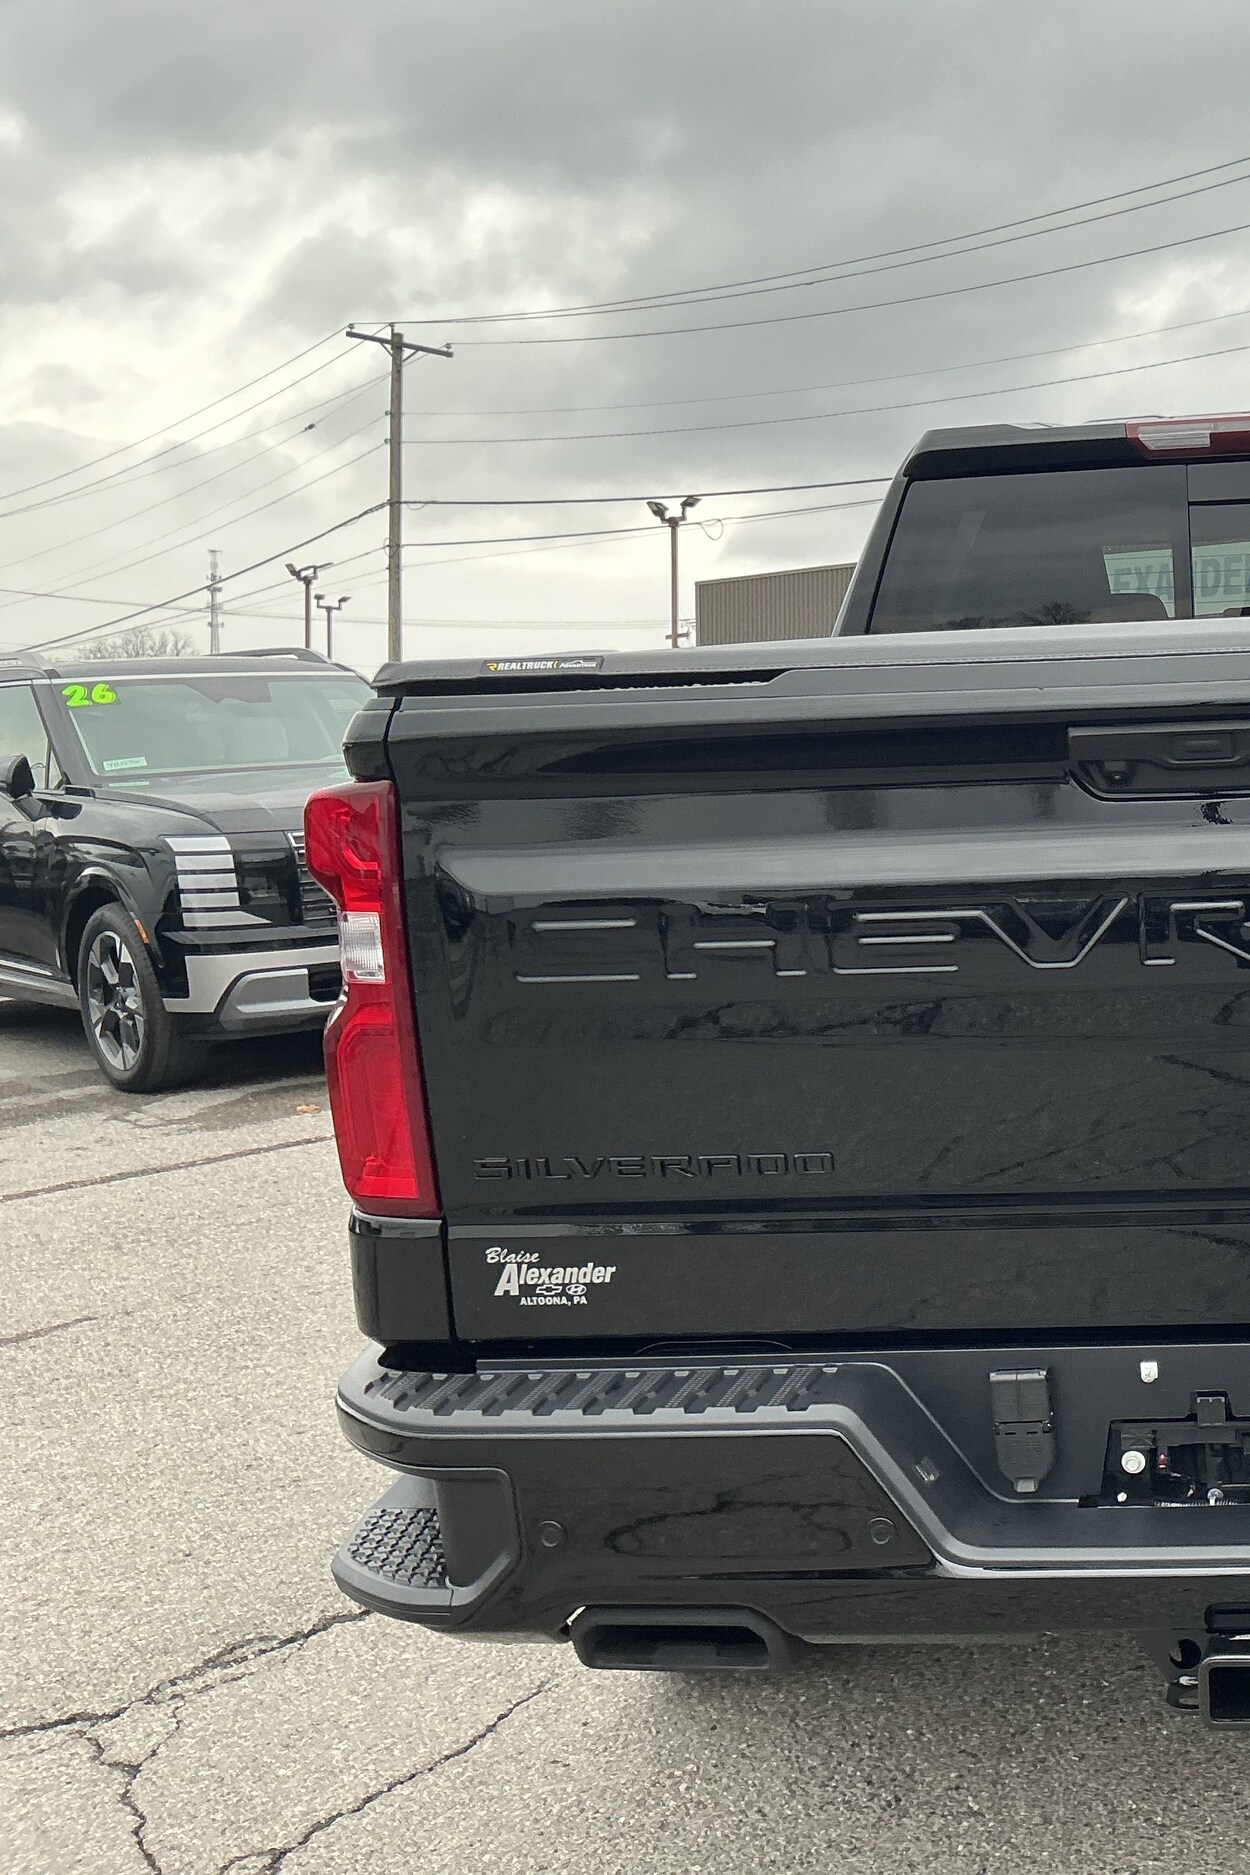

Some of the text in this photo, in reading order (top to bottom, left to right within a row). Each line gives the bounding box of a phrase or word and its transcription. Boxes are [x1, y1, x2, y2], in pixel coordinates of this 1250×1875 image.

[497, 661, 554, 671] REALTRUCK
[61, 683, 117, 707] 26
[473, 1151, 835, 1181] SILVERADO
[485, 1246, 541, 1264] Blaise
[494, 1262, 617, 1297] Alexander
[520, 1295, 588, 1306] ALTOONA, PA
